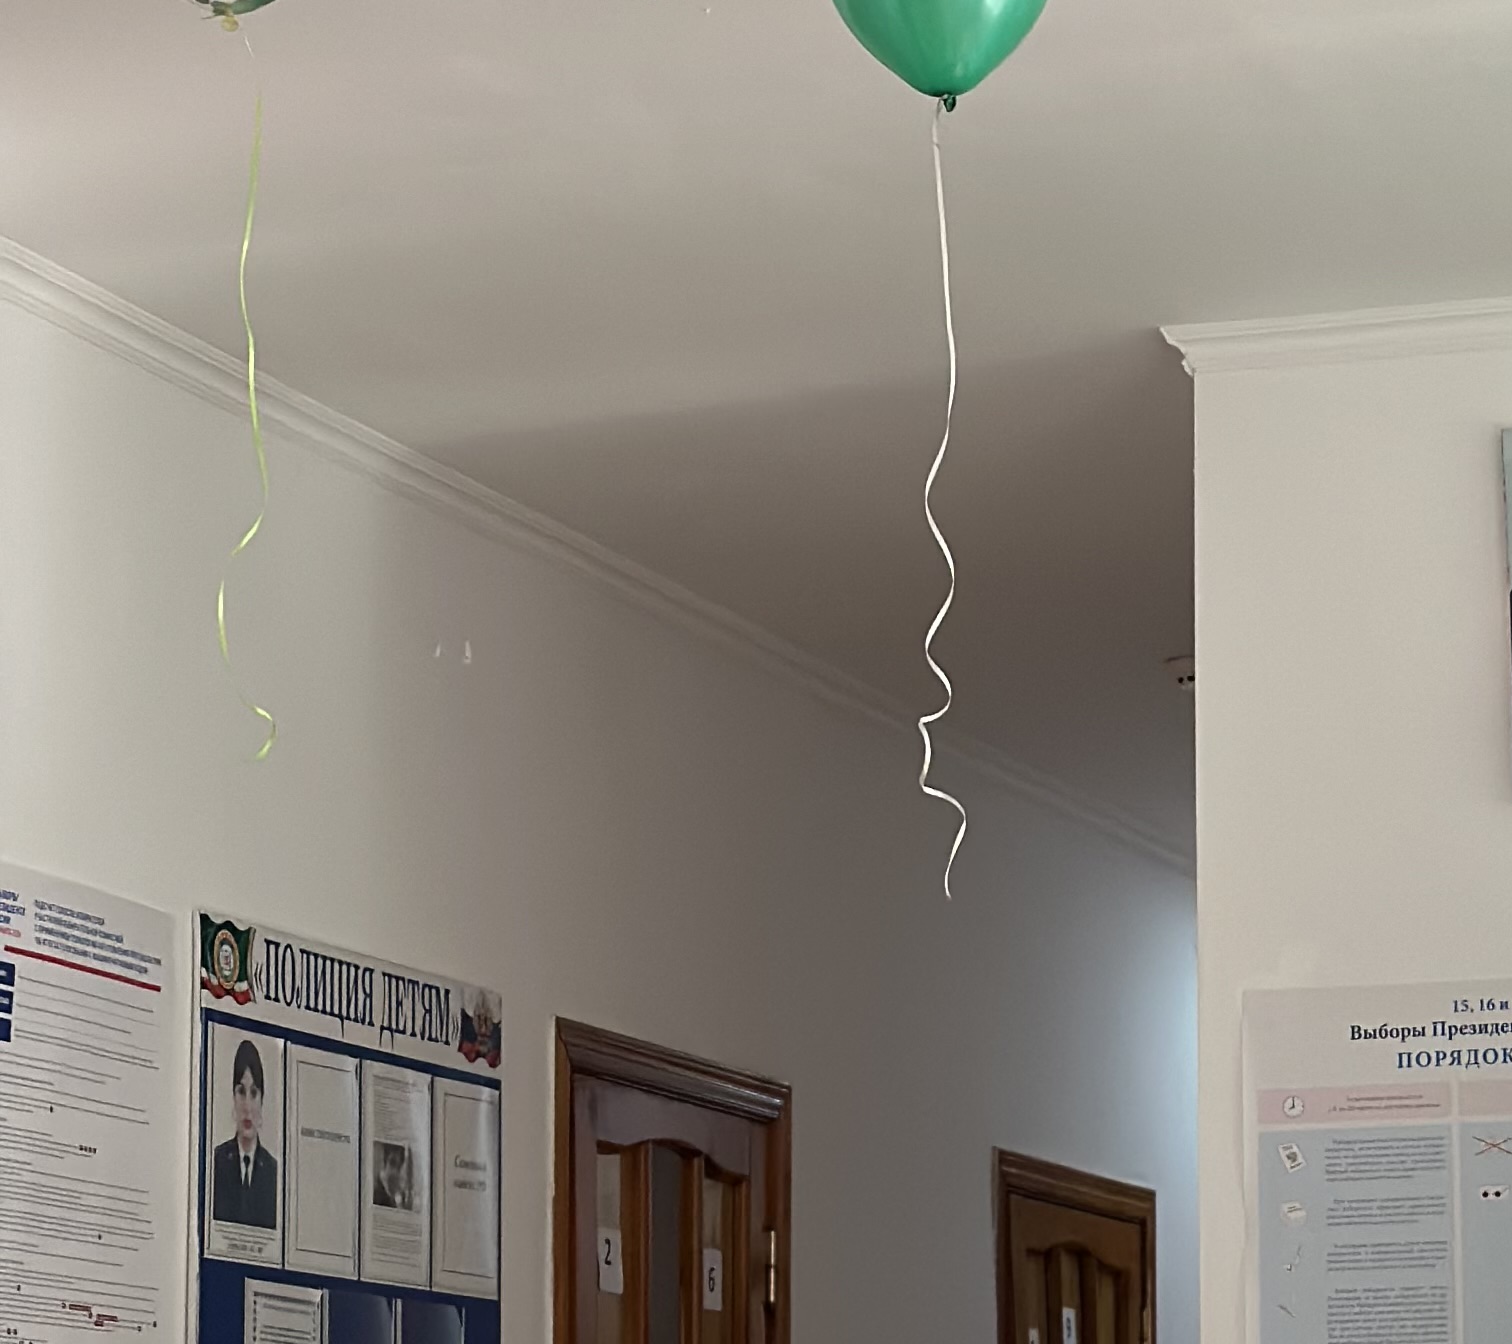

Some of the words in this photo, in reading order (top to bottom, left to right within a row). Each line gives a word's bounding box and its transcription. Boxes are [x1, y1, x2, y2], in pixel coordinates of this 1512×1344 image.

[1453, 999, 1474, 1013] 15,
[1479, 998, 1495, 1011] 16
[1500, 1000, 1509, 1010] и
[1350, 1023, 1426, 1043] Выборы
[604, 1238, 612, 1266] 2
[708, 1266, 716, 1293] 6
